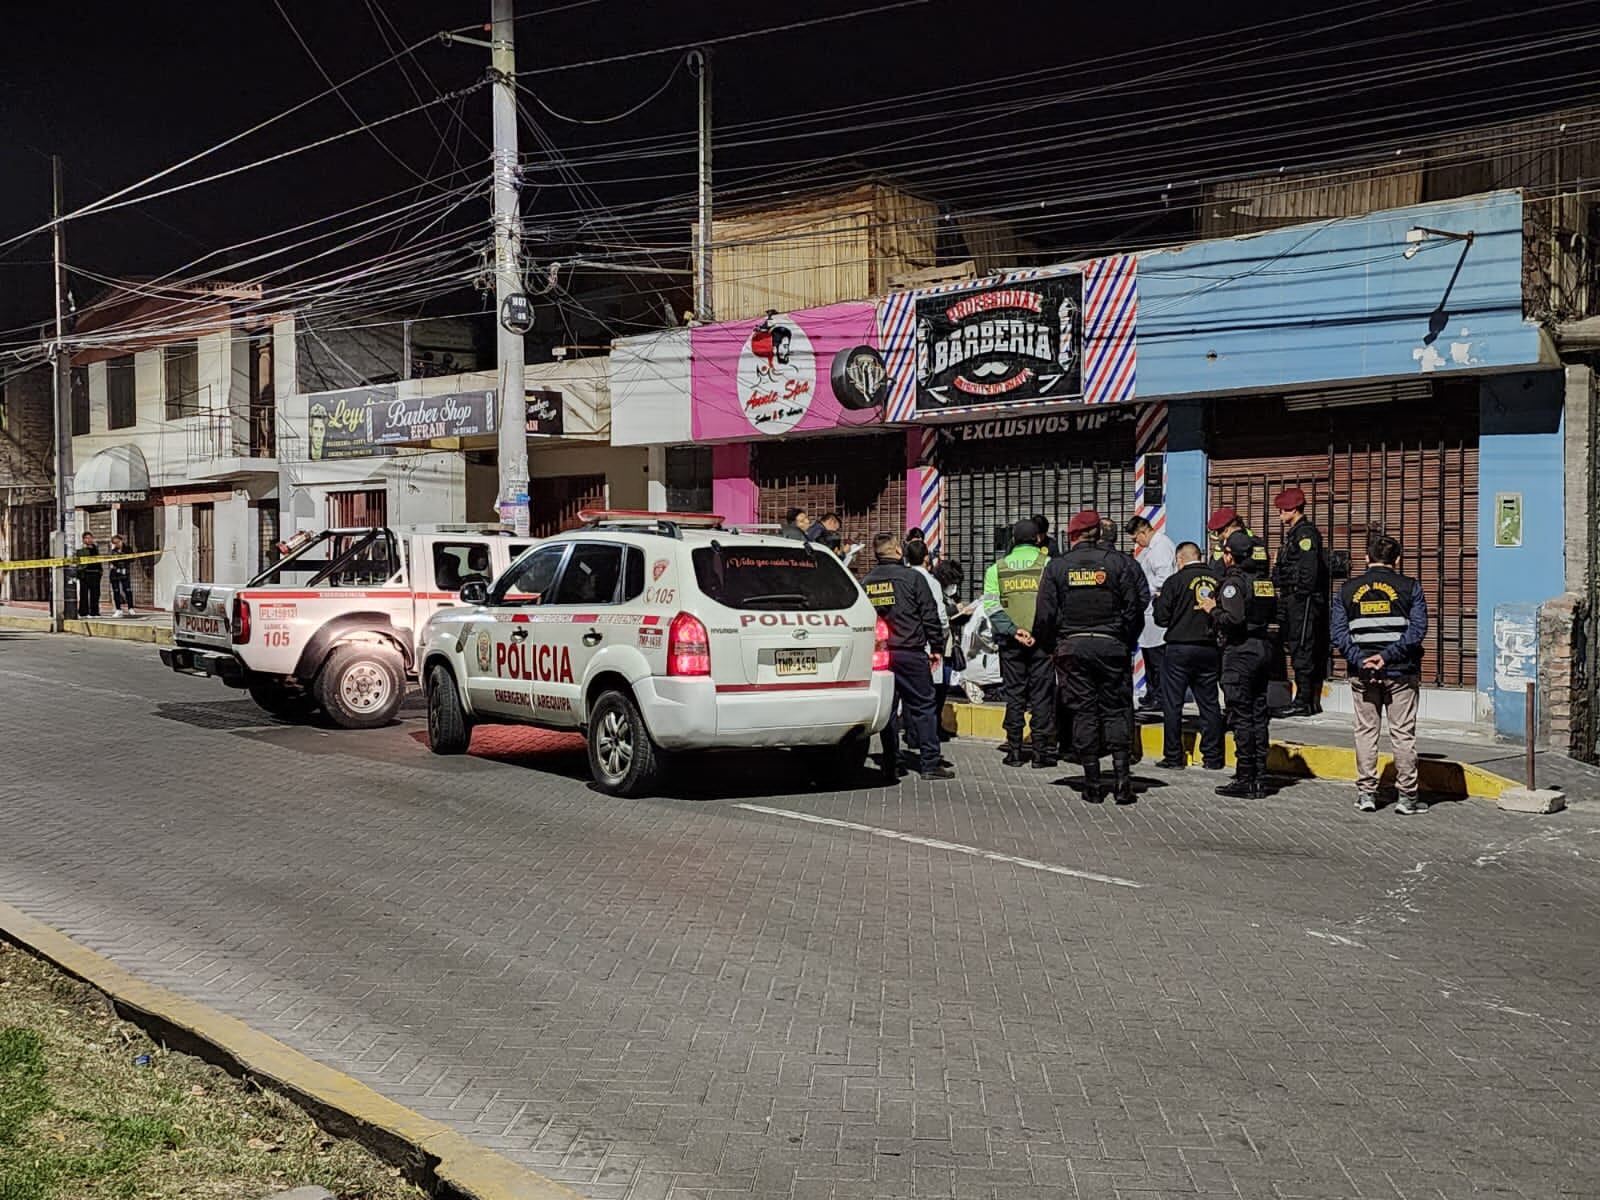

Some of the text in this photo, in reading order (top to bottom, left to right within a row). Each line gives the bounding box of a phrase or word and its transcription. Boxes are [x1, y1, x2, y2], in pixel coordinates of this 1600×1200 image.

[934, 319, 1052, 375] BARBERIA
[385, 397, 472, 429] Barber Shop
[410, 422, 447, 439] EFRAIN
[1004, 577, 1038, 591] POLICIA
[1068, 570, 1097, 581] POLICIA
[656, 587, 676, 605] 105
[866, 582, 895, 595] POLICIA
[185, 615, 220, 634] POLICIA
[740, 613, 850, 628] POLICIA
[264, 631, 290, 648] 105
[496, 642, 575, 684] POLICIA
